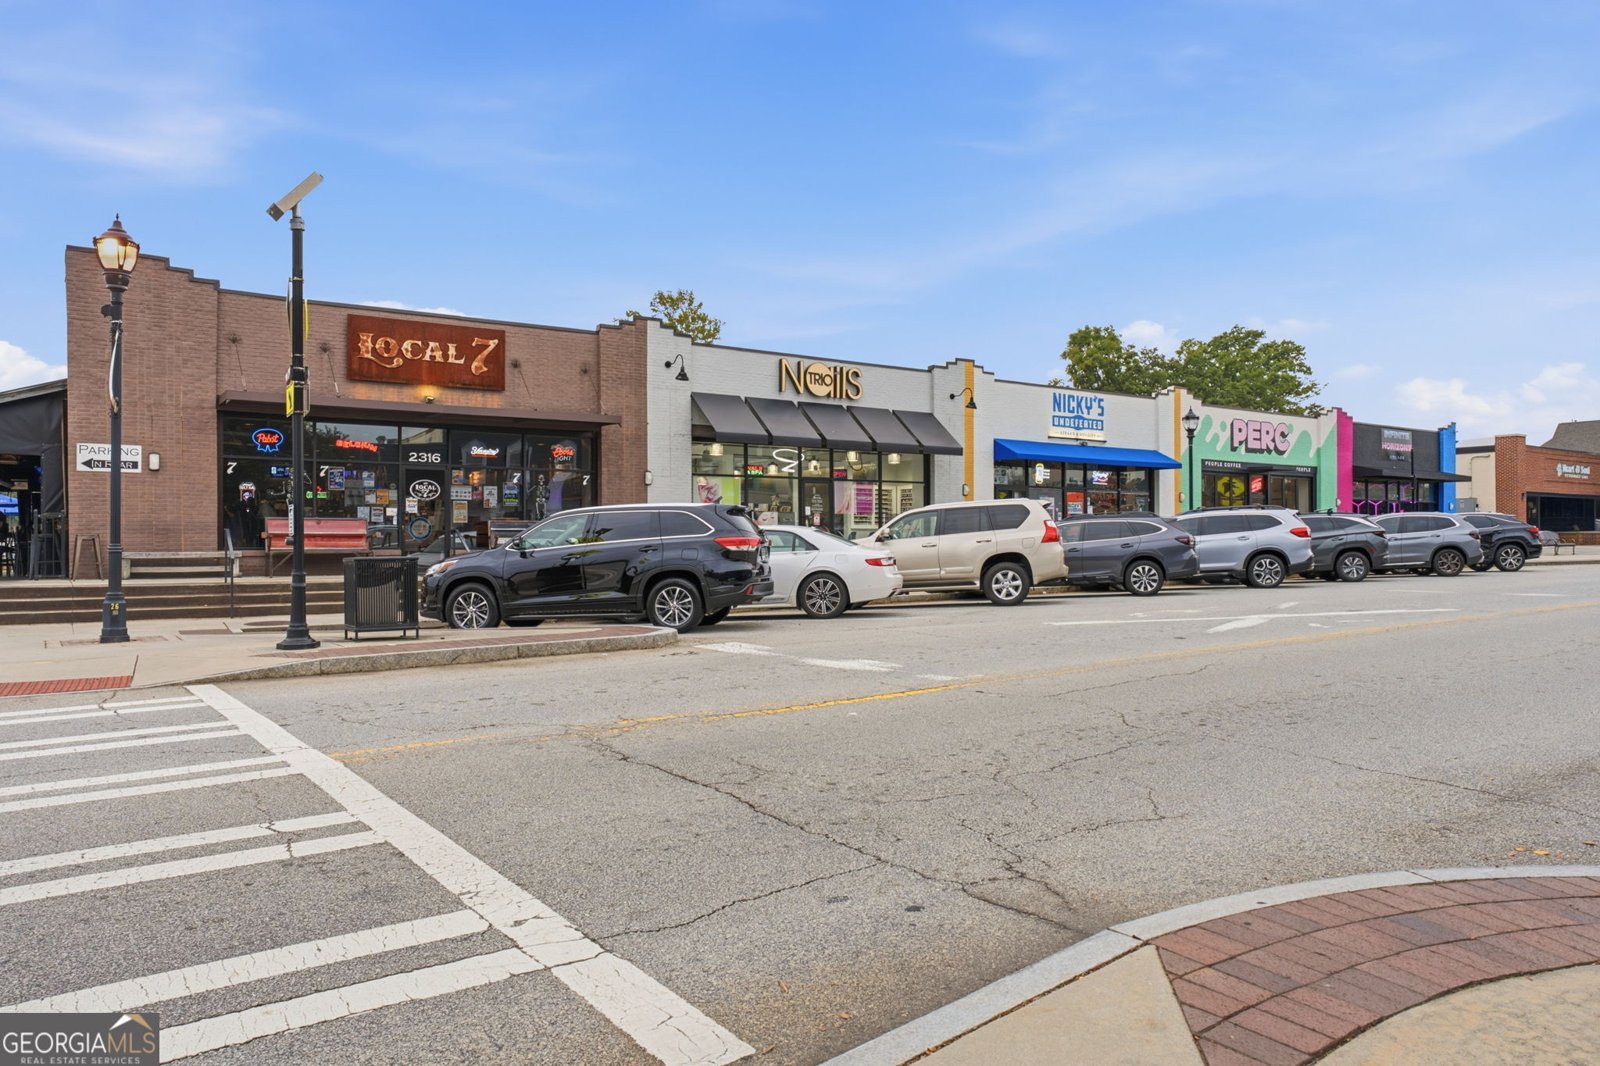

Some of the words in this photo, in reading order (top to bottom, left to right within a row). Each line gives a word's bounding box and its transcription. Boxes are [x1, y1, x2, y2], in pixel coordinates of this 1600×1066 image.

[356, 332, 466, 368] LOCAL
[471, 337, 499, 376] 7
[808, 371, 833, 387] TRIO
[1053, 392, 1104, 417] NICKY'S
[1053, 417, 1102, 430] UNDEFEATED
[256, 432, 280, 444] Pabst
[1231, 418, 1291, 455] PERC
[79, 445, 140, 456] PARNG
[408, 452, 441, 463] 2316
[92, 460, 102, 468] IN
[104, 461, 133, 469] RAR
[226, 462, 237, 474] 7
[320, 465, 329, 477] 7
[513, 472, 521, 483] 7
[582, 475, 591, 486] 7
